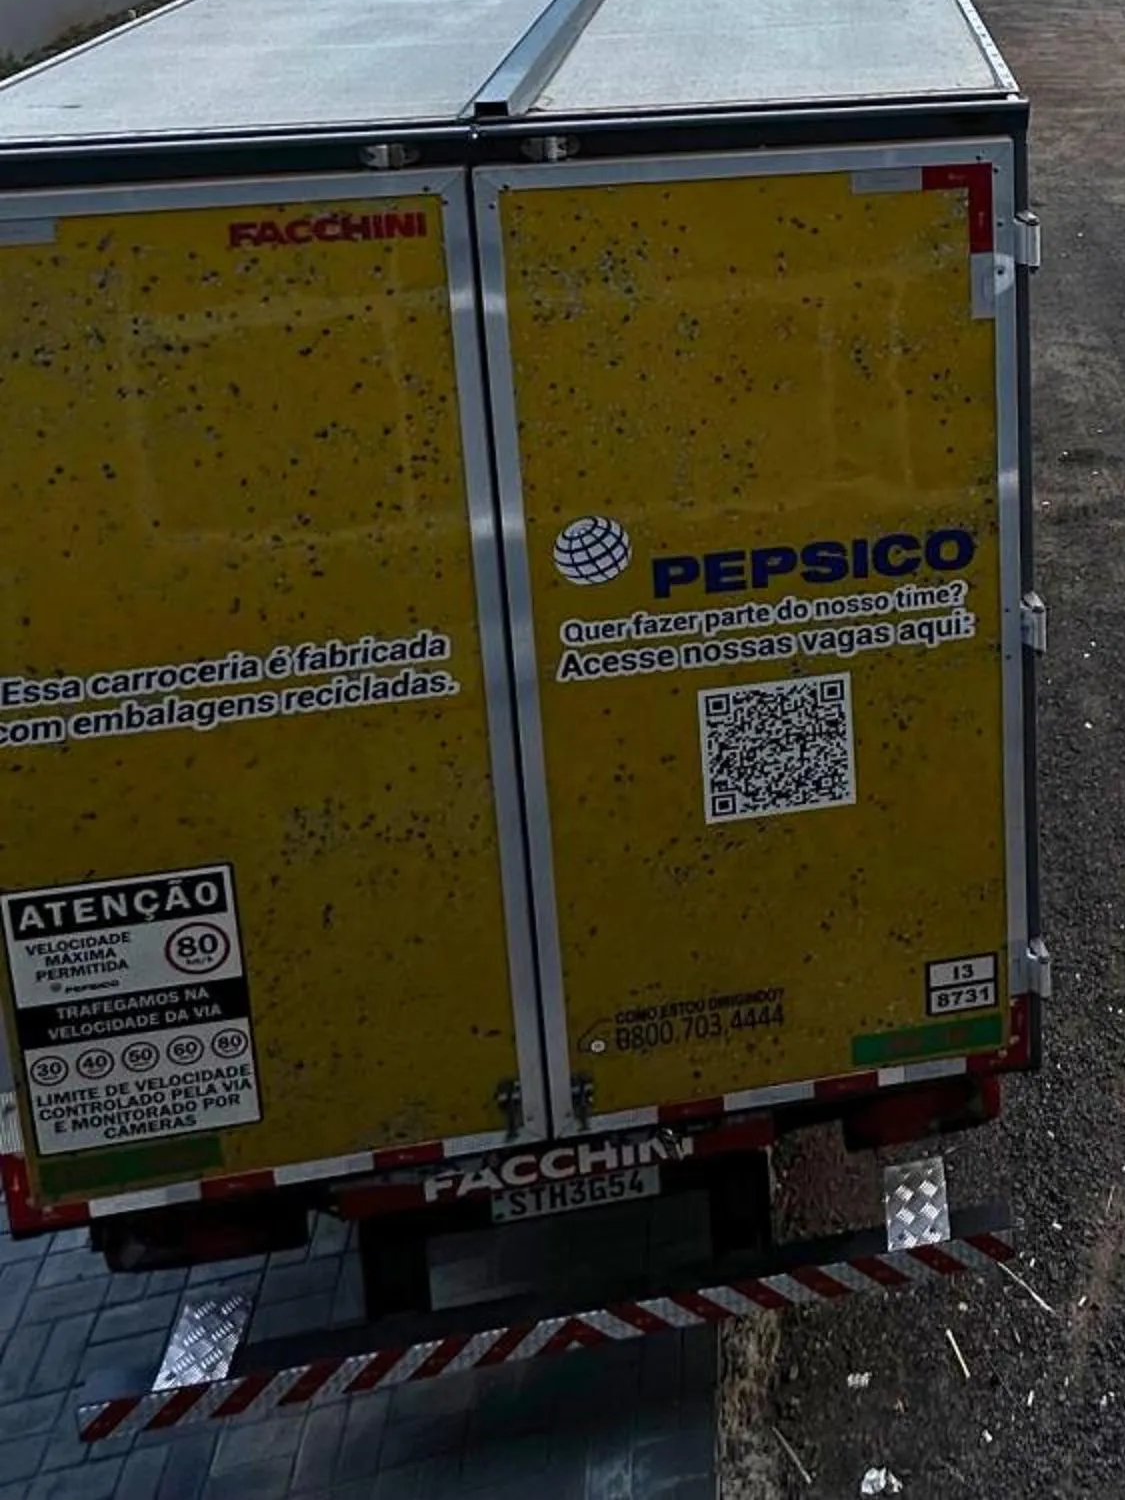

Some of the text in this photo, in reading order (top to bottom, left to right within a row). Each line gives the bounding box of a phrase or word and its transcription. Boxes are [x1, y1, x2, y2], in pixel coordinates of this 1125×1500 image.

[229, 211, 427, 249] FACCHINI
[652, 528, 977, 599] PEPSICO
[564, 583, 963, 645] Quer fazer parte do nosso time?
[561, 610, 974, 679] Acesse nossas vagas aqui:
[2, 632, 447, 707] Essa carroceria é fabricada
[73, 692, 274, 737] embalagens
[285, 670, 457, 711] recicladas.
[19, 879, 219, 931] ATENÇÃO
[25, 931, 131, 957] VELOCIDADE
[177, 933, 219, 959] 80
[36, 959, 129, 982] PERMITIDA
[953, 963, 974, 980] 13
[56, 986, 210, 1021] TRAFEGAMOS NA
[937, 987, 989, 1008] 8731
[47, 1003, 223, 1041] VELOCIDADE DA VIA
[37, 1034, 243, 1078] 30 40 50 60 80
[36, 1064, 252, 1108] LIMITE DE VELOCIDADE
[39, 1077, 253, 1121] CONTROLADO PELA VIA
[54, 1092, 241, 1134] E MONITORADO POR
[510, 1169, 644, 1217] STH3G54
